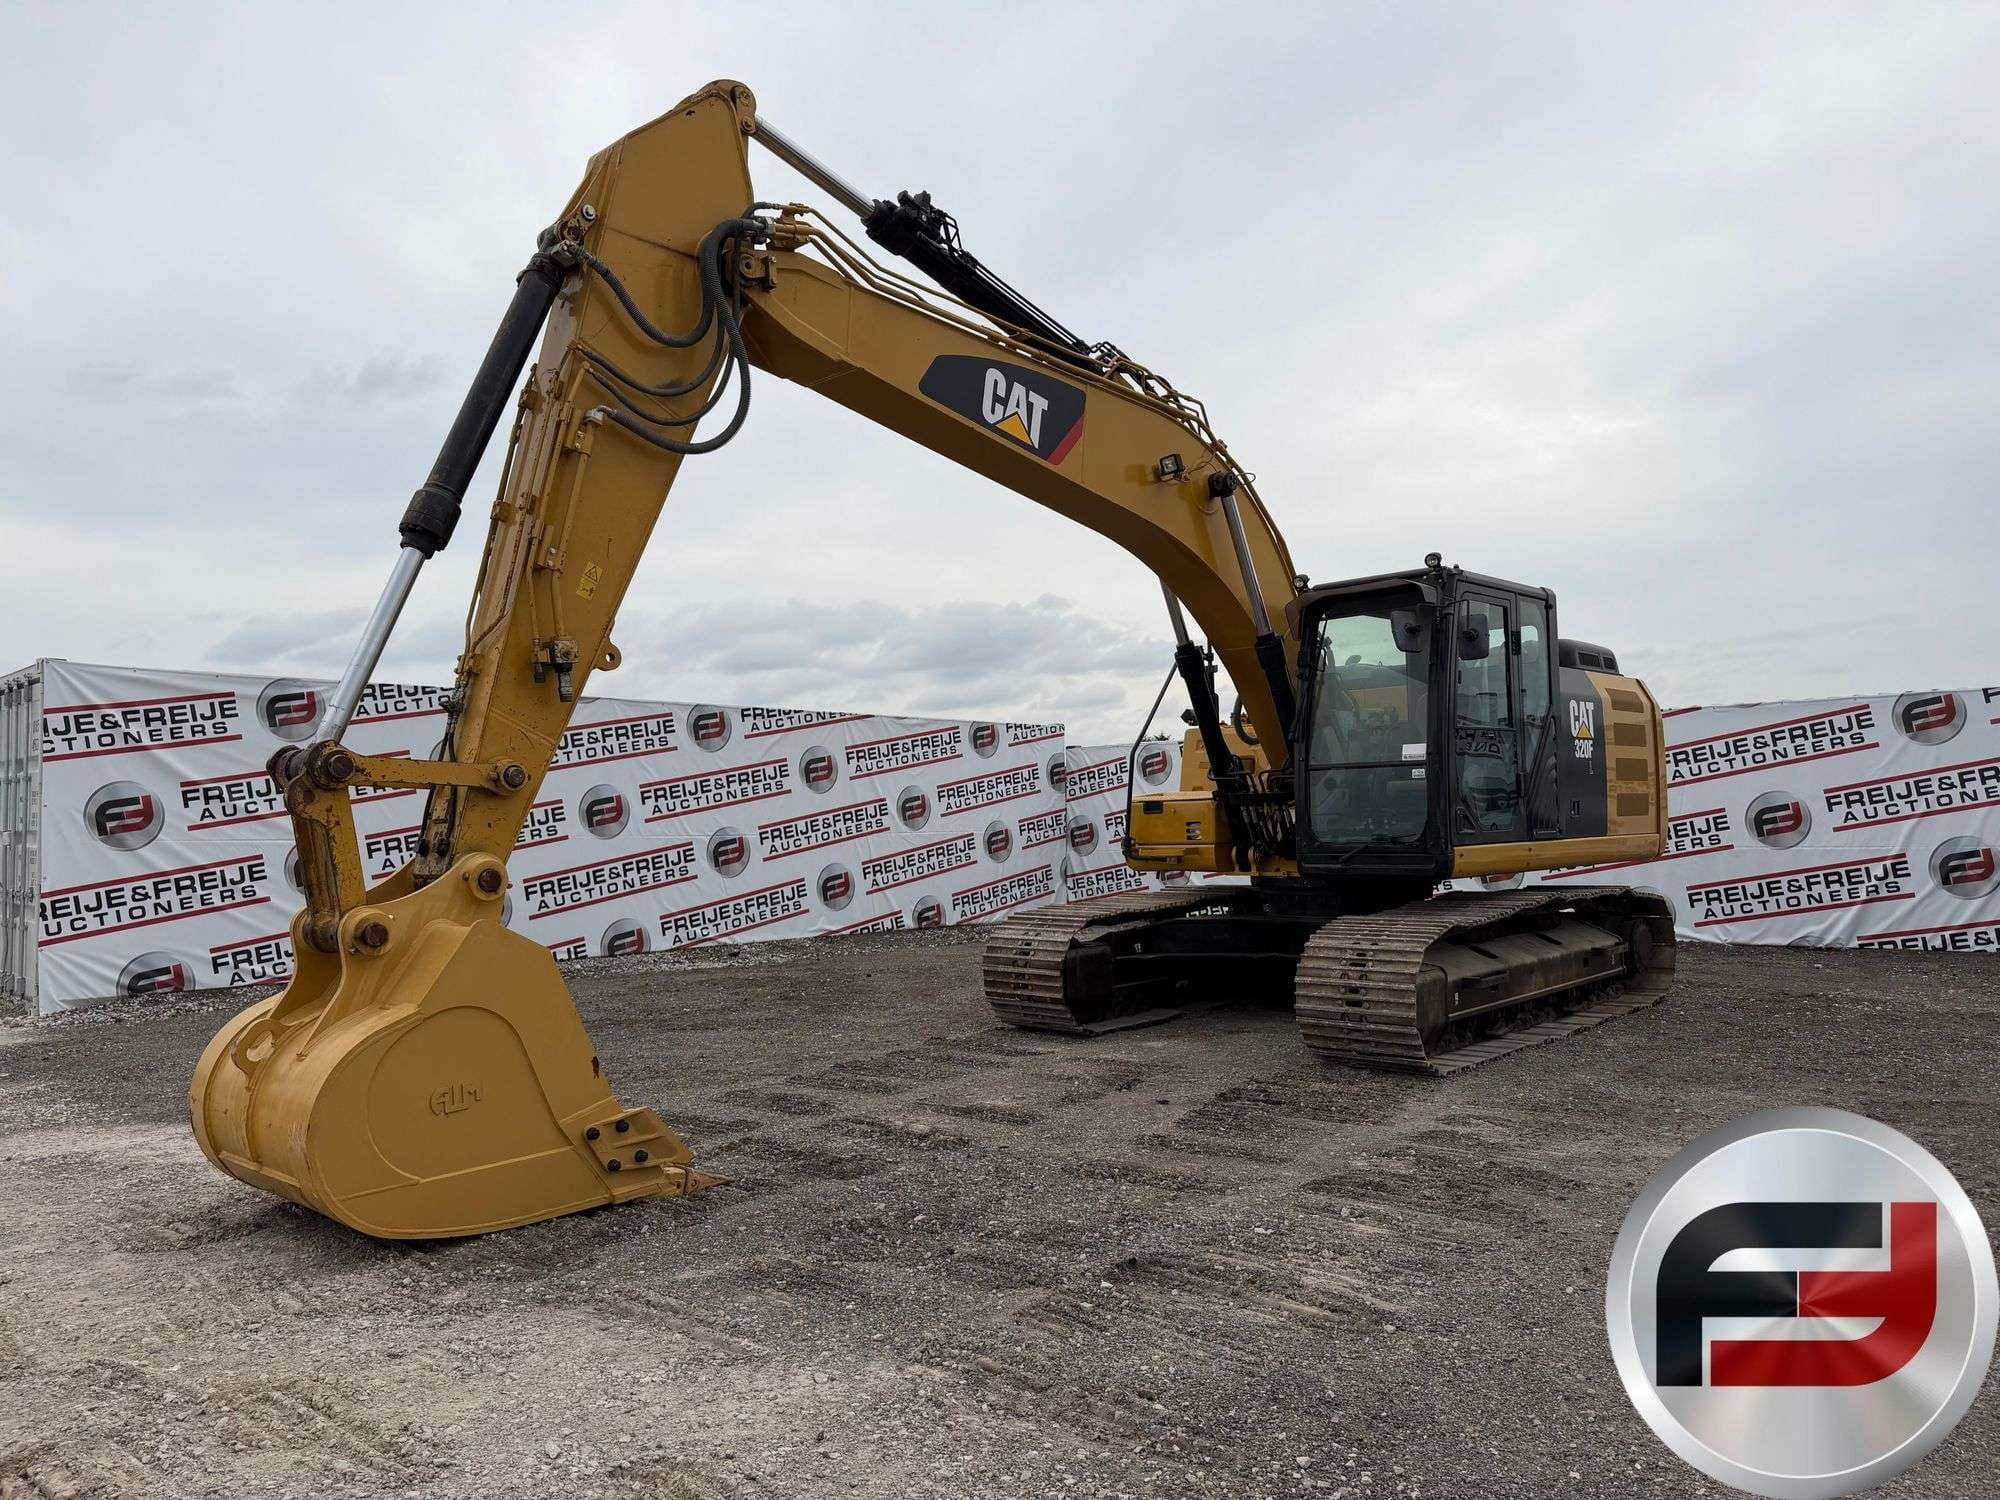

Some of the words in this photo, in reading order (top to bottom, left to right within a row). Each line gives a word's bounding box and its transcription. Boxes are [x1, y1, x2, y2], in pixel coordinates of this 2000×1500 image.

[982, 368, 1048, 449] CAT
[1569, 700, 1594, 738] CAT
[846, 731, 961, 764] FREIJE&FREIJE
[855, 745, 957, 773] AUCTIONEERS
[1575, 740, 1593, 758] 320F
[1672, 732, 1865, 780] AUCTIONEERS
[640, 764, 790, 805] FREIJE&FREIJE
[938, 768, 1039, 802] FREIJE&FREIJE
[1066, 761, 1128, 788] &FREIJE
[652, 780, 784, 815] AUCTIONEERS
[945, 781, 1036, 811] AUCTIONEERS
[759, 803, 889, 845] FREIJE&FREIJE
[769, 819, 884, 854] AUCTIONEERS
[1018, 814, 1067, 836] FREIJE
[524, 848, 696, 901] FREIJE&FREIJE
[862, 838, 976, 880] FREIJE&FREIJE
[871, 852, 972, 888] AUCTIONEERS
[537, 865, 689, 911] AUCTIONEERS
[952, 869, 1053, 911] FREIJE&FREIJE
[960, 883, 1050, 919] AUCTIONEERS
[1688, 860, 1911, 908] FREIJE&FREIJE
[1704, 881, 1901, 919] AUCTIONEERS
[660, 883, 808, 936] FREIJE&FREIJE
[672, 900, 802, 945] AUCTIONEERS
